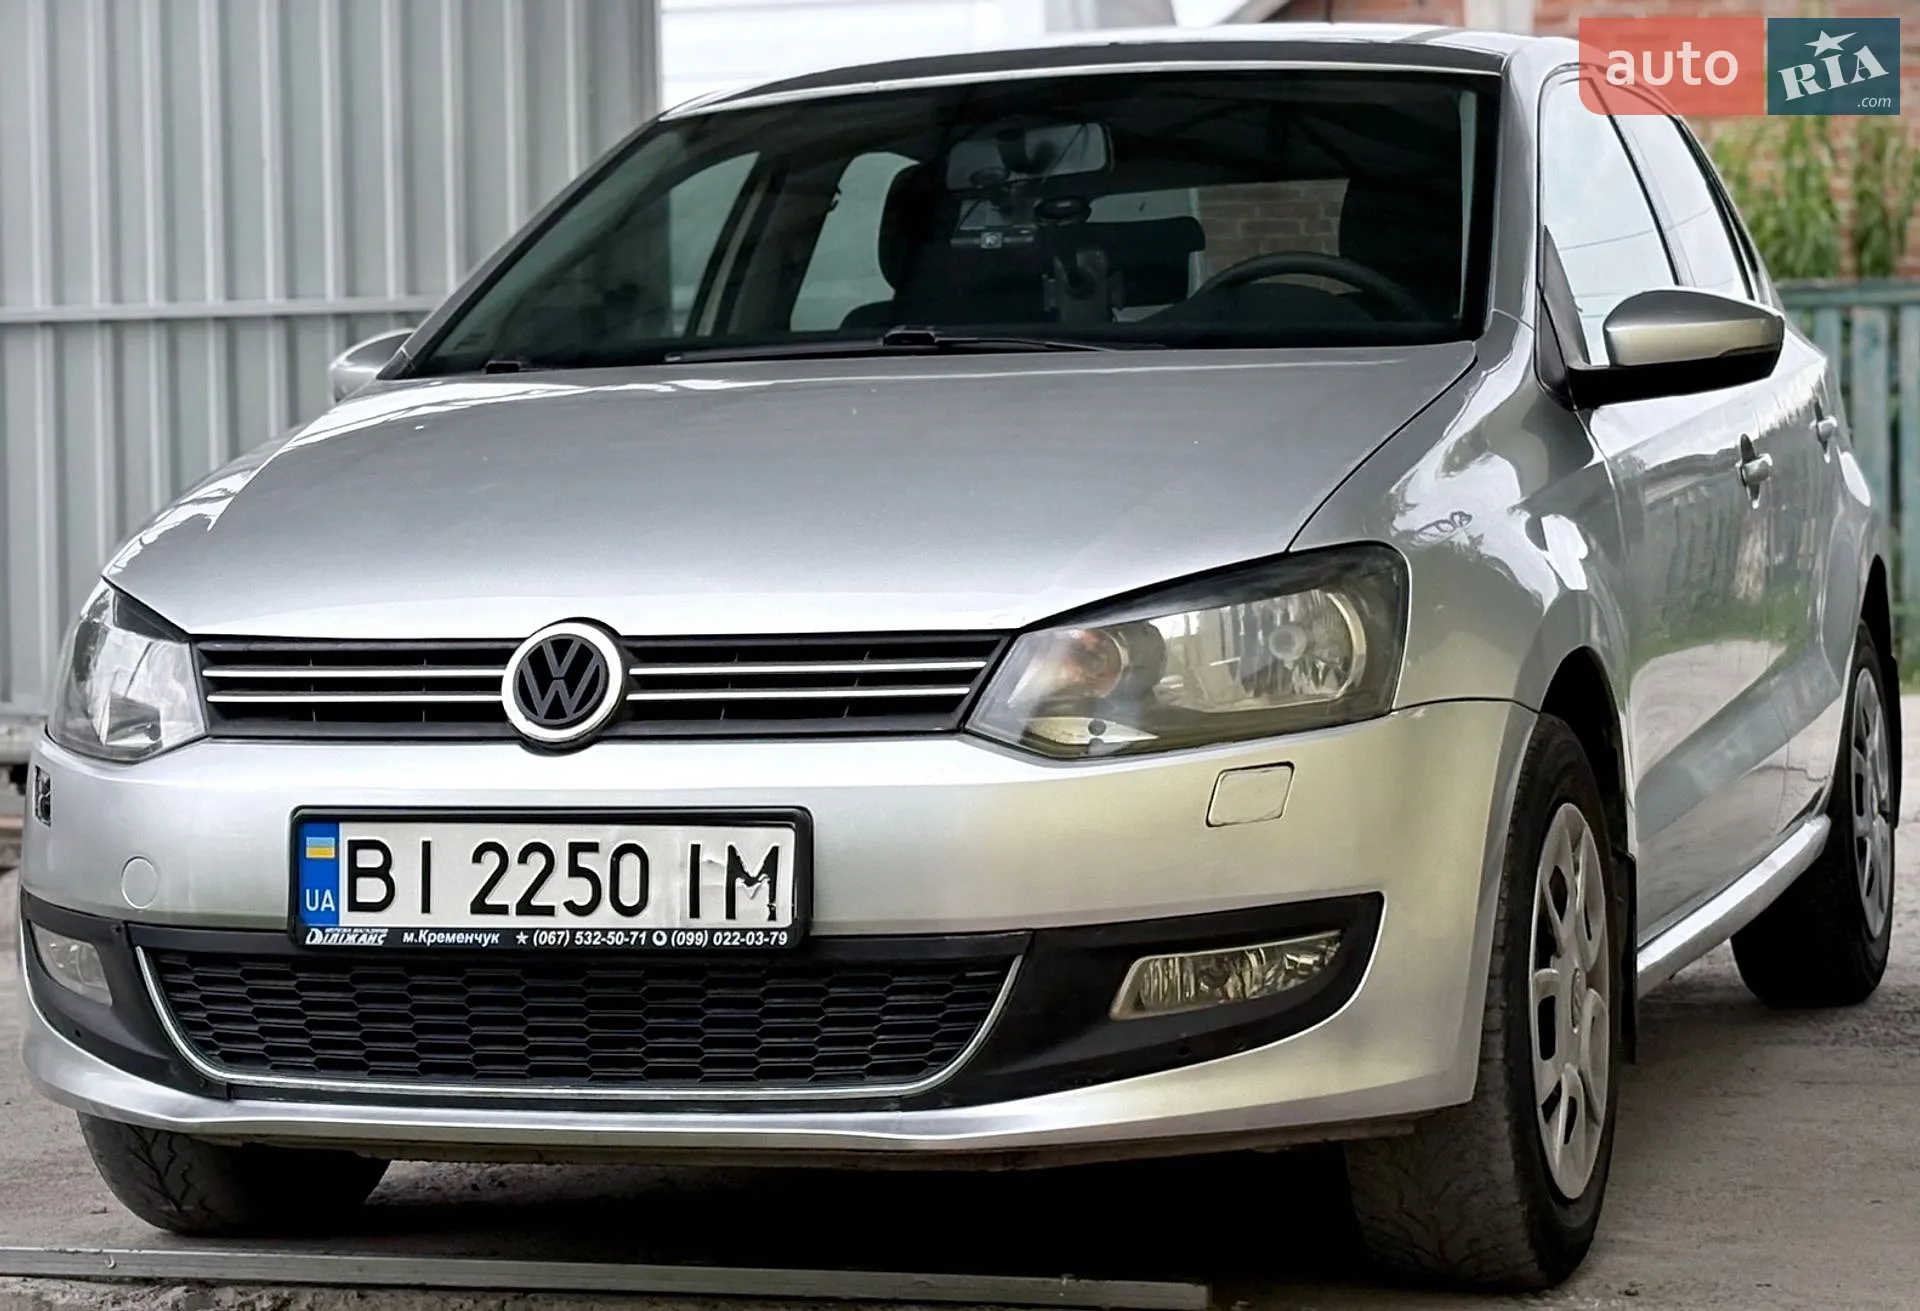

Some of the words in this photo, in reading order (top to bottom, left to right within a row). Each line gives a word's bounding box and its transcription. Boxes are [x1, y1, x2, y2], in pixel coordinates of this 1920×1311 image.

[469, 840, 649, 918] 2250
[306, 889, 336, 912] UA
[402, 929, 500, 947] м.Кременчук
[532, 929, 570, 947] (067)
[574, 930, 647, 946] 532-50-71
[671, 930, 709, 947] (099)
[713, 930, 788, 946] 022-03-79
